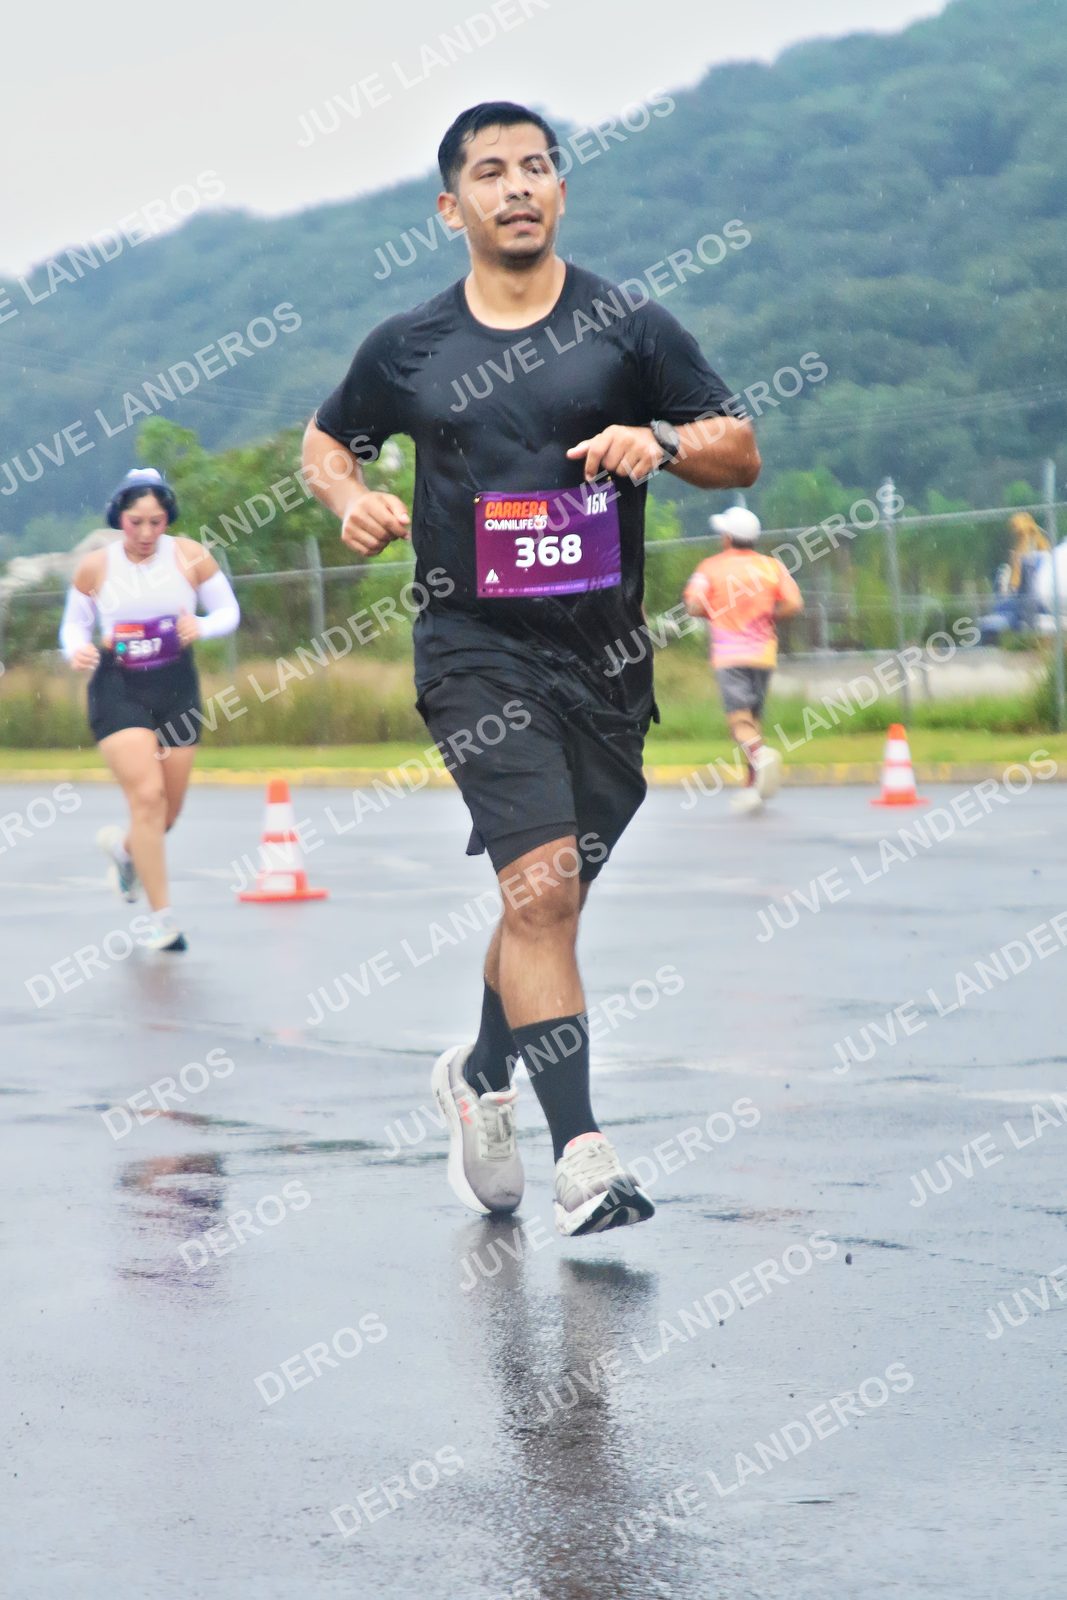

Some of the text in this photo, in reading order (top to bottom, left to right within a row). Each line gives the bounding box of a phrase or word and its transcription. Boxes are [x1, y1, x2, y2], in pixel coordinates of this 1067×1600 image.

[485, 501, 548, 518] CARRERA
[586, 492, 608, 516] 15K
[485, 518, 534, 531] OMNILIFE
[515, 533, 582, 568] 368
